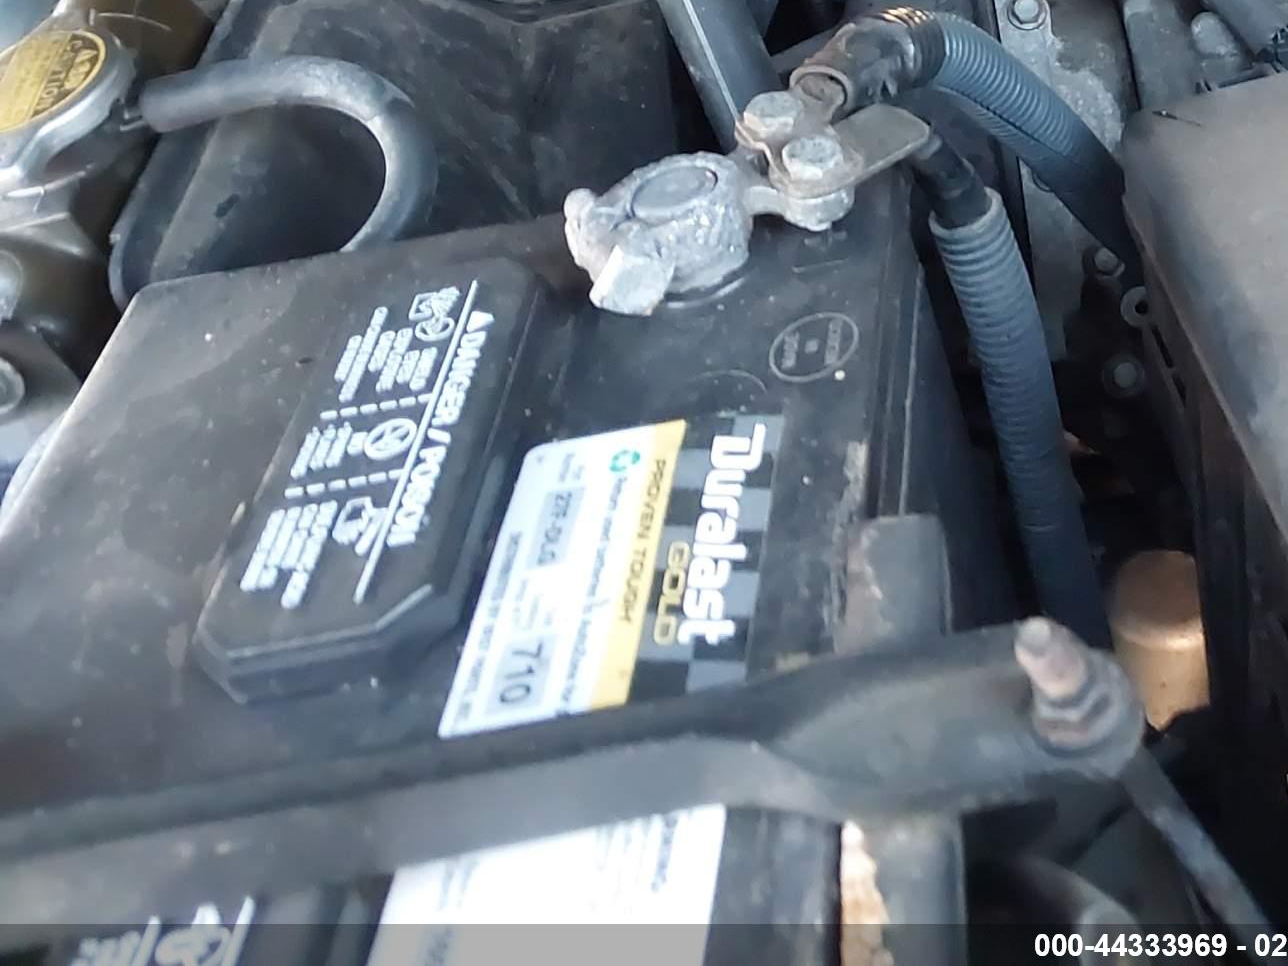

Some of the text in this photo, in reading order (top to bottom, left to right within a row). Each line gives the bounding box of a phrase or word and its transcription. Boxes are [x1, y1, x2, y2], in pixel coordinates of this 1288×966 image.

[432, 331, 487, 426] DANGER
[428, 428, 451, 443] /
[622, 459, 666, 623] PROVEN TOUGH
[677, 423, 766, 645] Duralast
[654, 540, 690, 645] GOLD
[499, 642, 543, 705] 710
